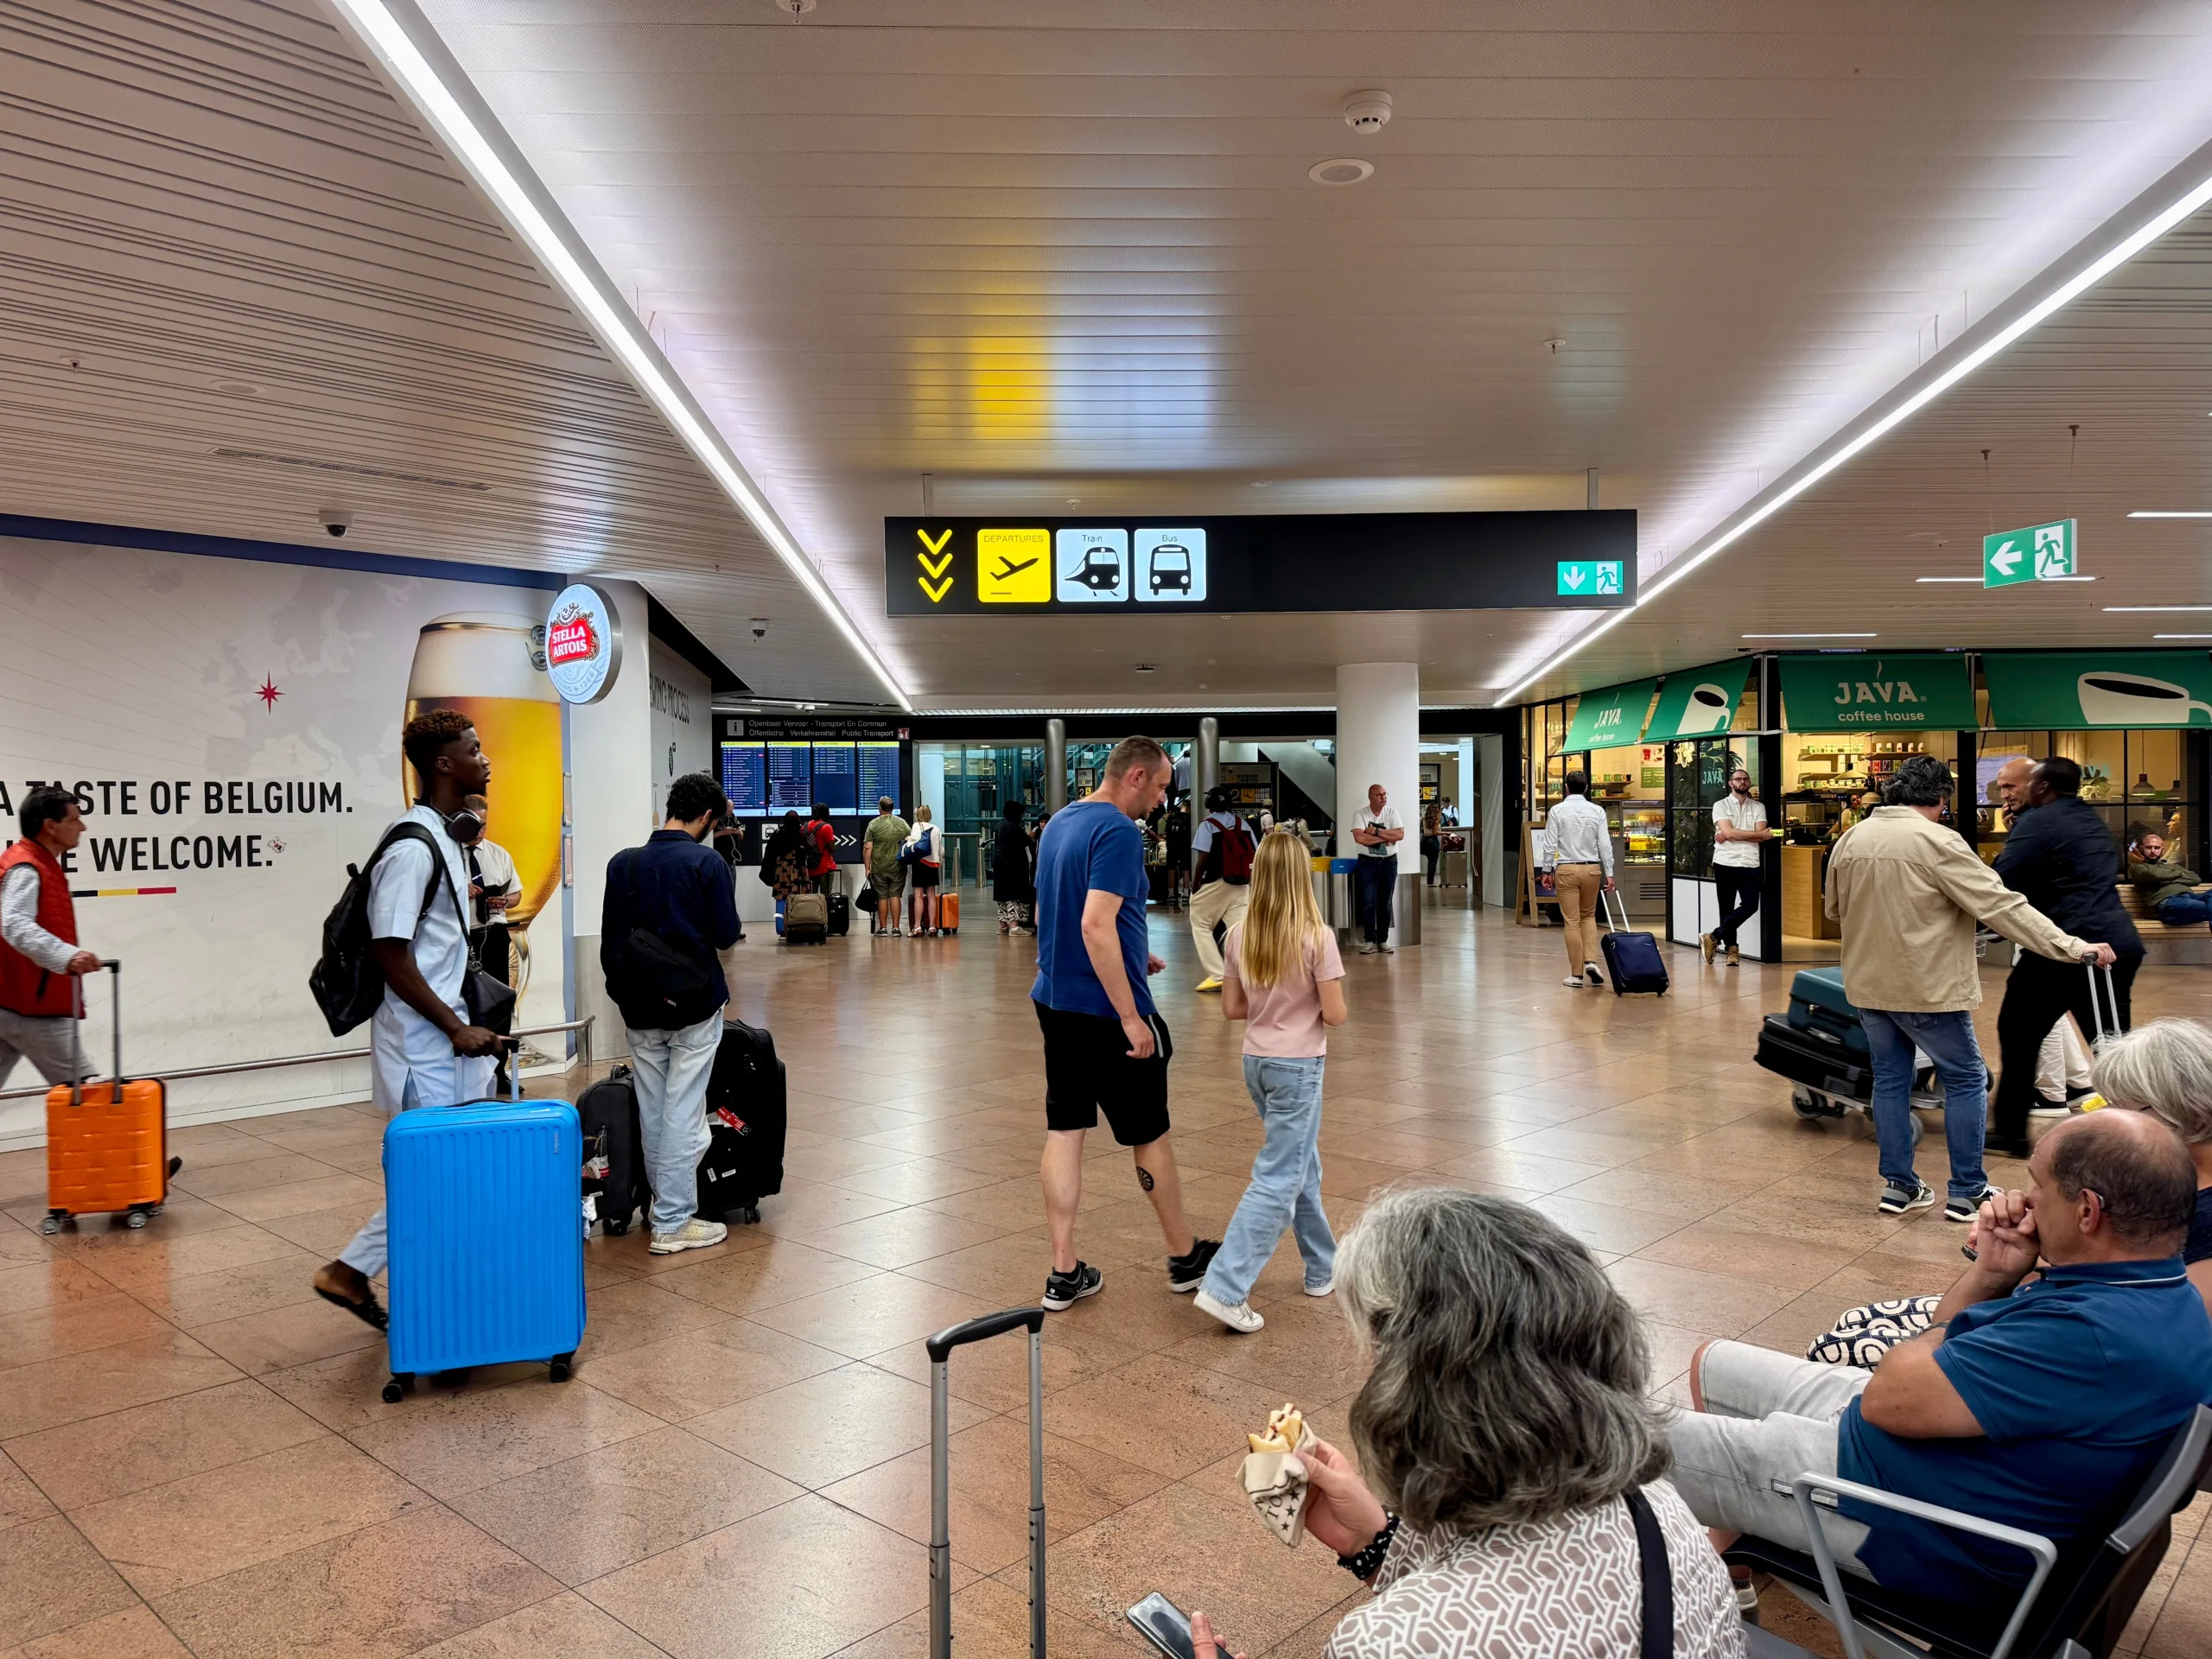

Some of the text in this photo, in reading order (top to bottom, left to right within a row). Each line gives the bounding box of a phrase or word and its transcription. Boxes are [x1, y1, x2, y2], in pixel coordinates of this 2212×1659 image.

[552, 626, 587, 645] STELLA
[553, 639, 588, 658] ARTOIS
[580, 671, 594, 689] 1366
[1834, 681, 1918, 704] JAVA
[1593, 707, 1622, 729] JAVA
[1838, 710, 1924, 721] coffee house
[1701, 770, 1723, 785] JAVA
[150, 781, 191, 815] OF
[204, 781, 353, 814] BELGIUM.
[1078, 788, 1084, 798] 2
[1230, 788, 1240, 803] 2
[90, 835, 273, 872] WELCOME.
